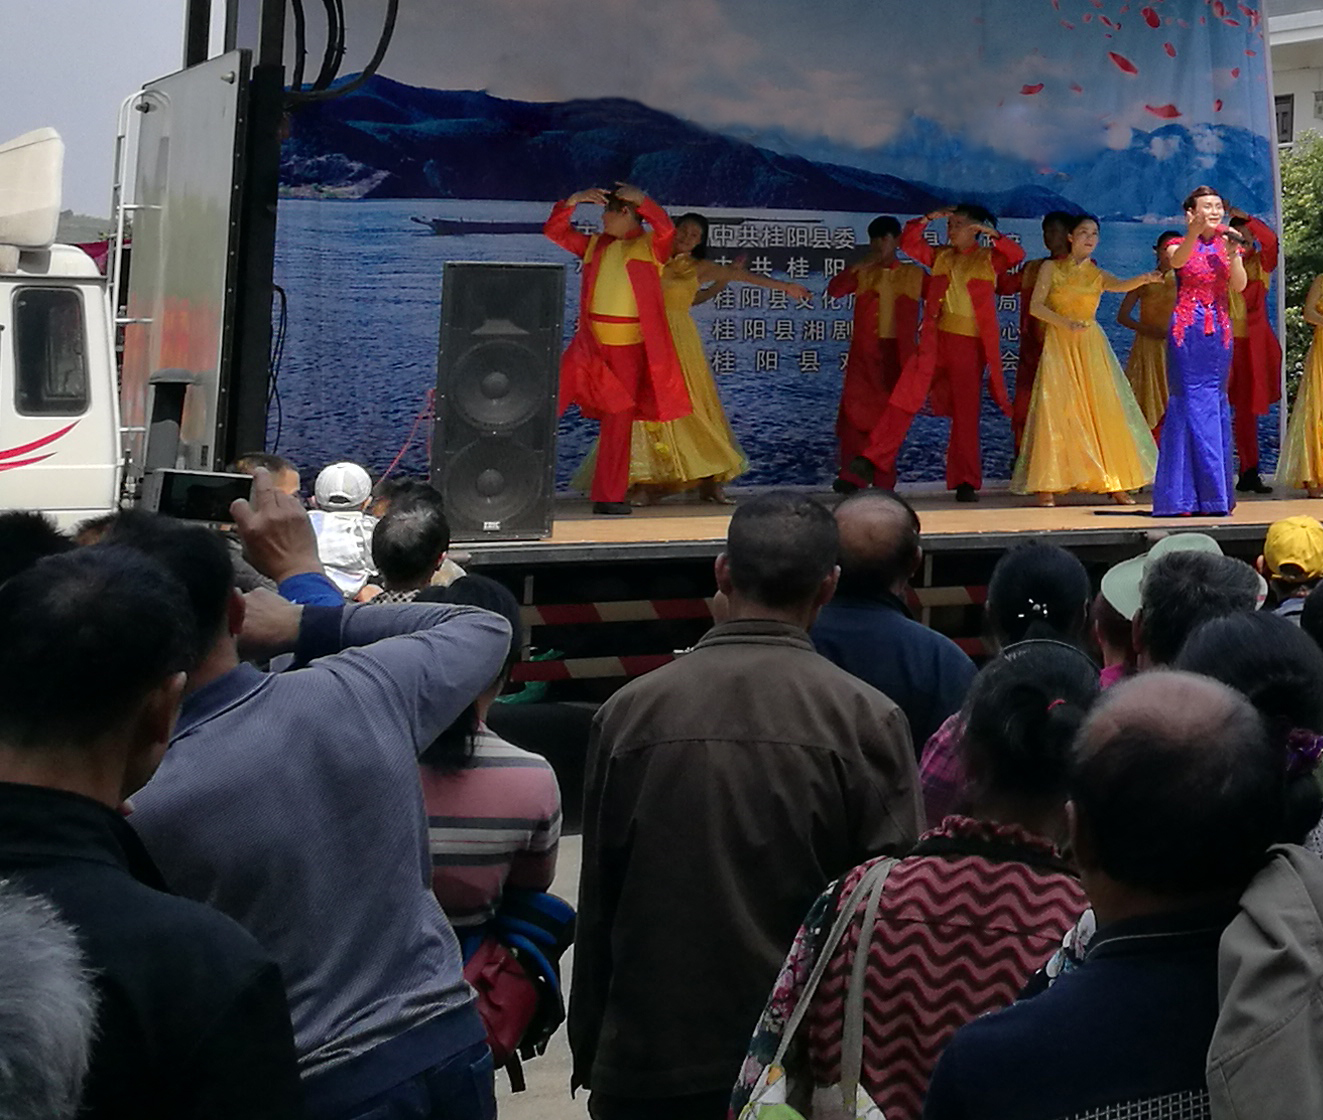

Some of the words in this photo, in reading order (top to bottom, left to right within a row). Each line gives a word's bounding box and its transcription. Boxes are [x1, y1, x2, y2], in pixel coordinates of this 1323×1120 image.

[714, 225, 855, 250] 中共桂阳县委
